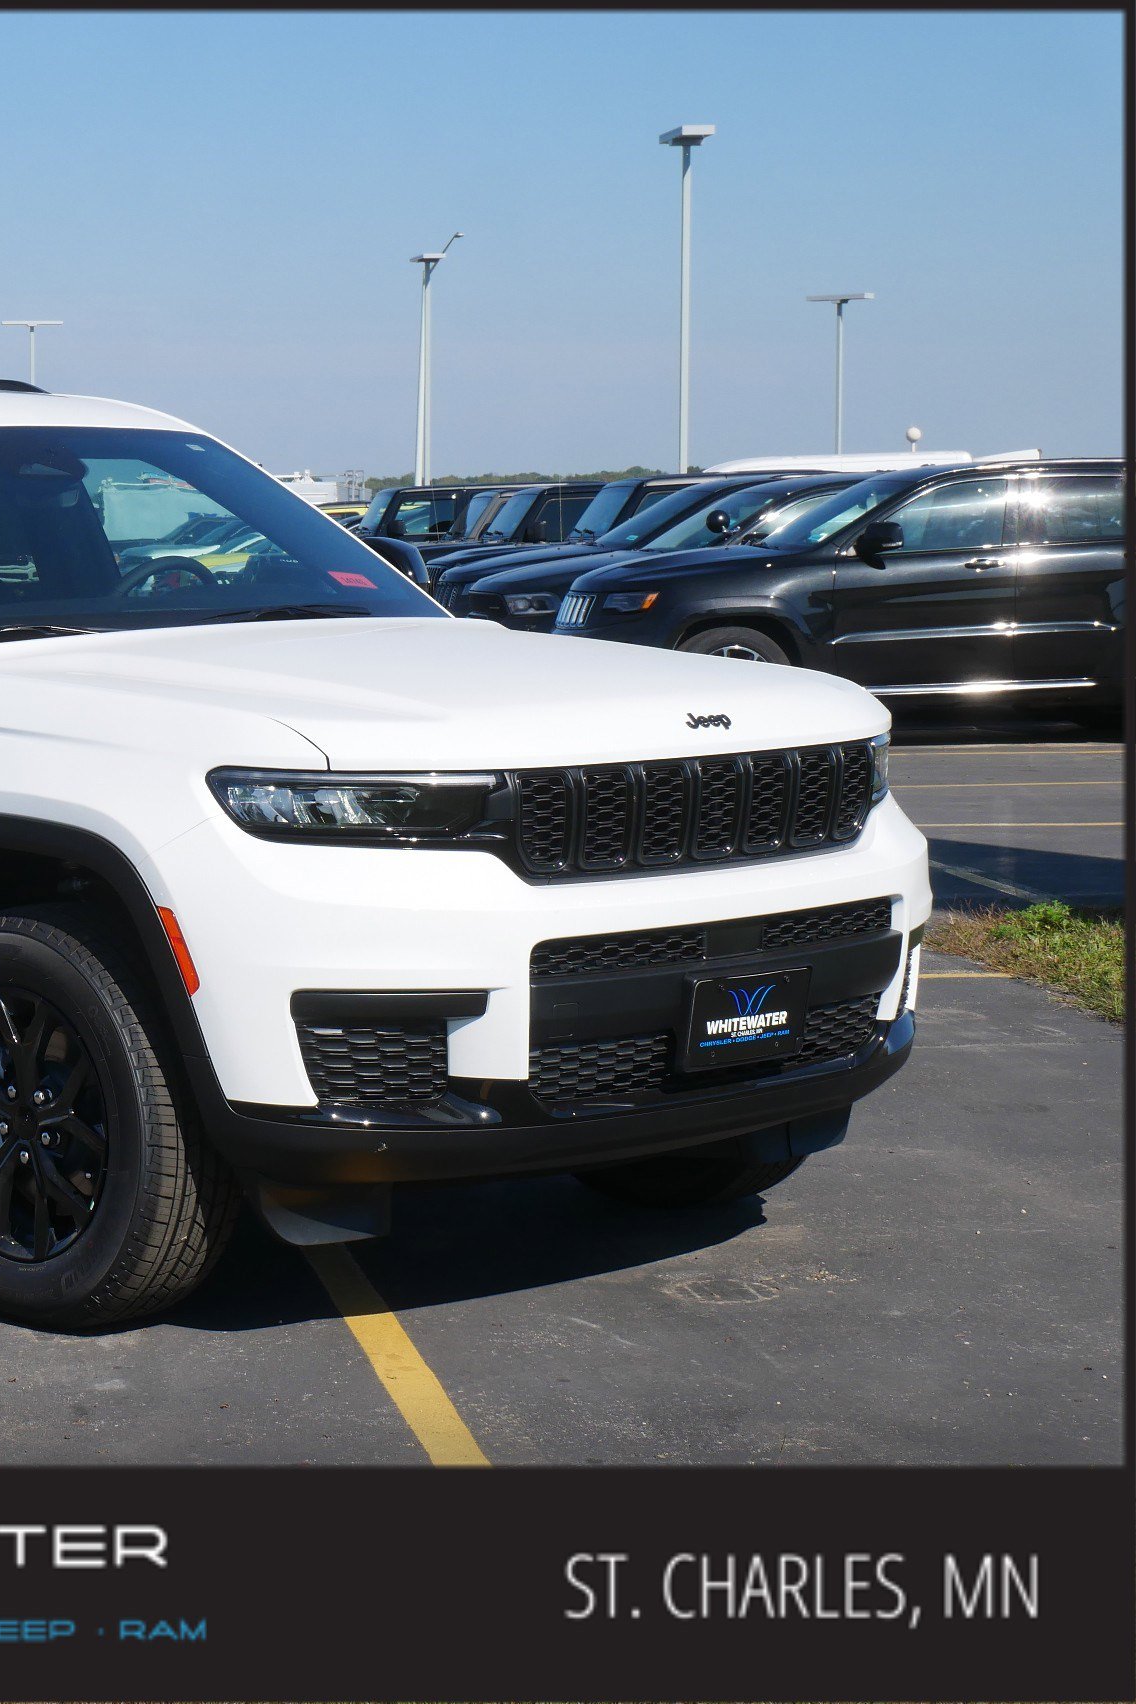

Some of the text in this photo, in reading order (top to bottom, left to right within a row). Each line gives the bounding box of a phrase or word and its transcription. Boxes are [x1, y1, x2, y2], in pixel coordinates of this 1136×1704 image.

[685, 712, 732, 730] Jeep
[706, 1010, 788, 1035] WHITEWATER
[699, 1038, 732, 1048] CHRYSLER
[736, 1035, 757, 1043] DODGE
